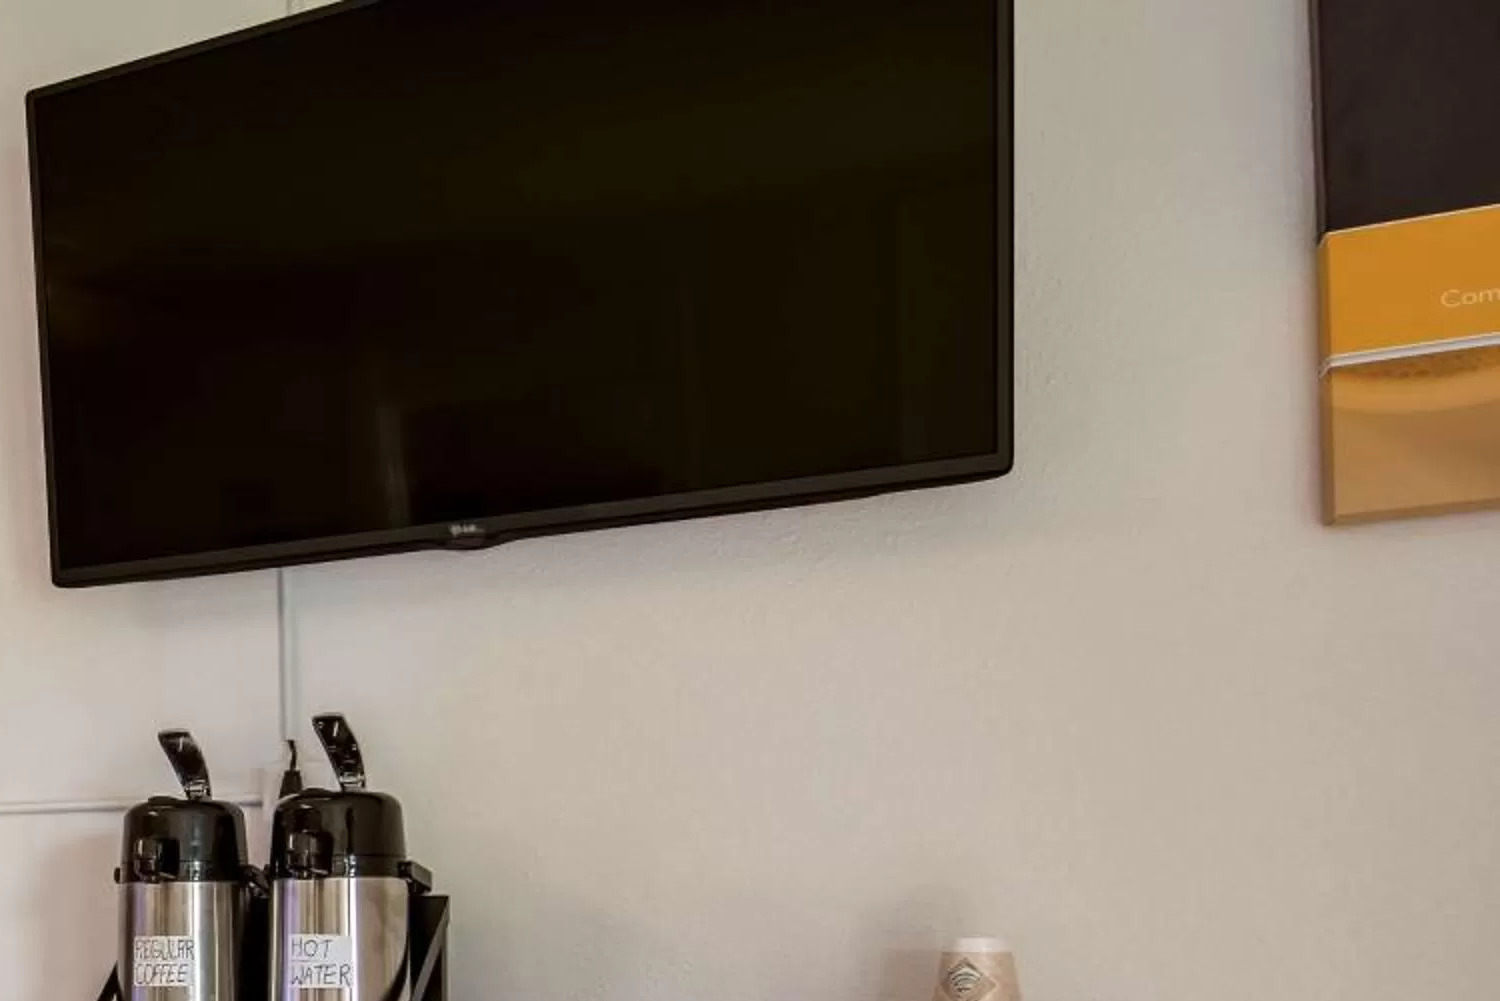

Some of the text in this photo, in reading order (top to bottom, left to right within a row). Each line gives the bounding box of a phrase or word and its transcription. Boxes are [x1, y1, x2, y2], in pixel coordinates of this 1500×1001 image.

[134, 939, 195, 960] REGULAR
[291, 939, 332, 958] HOT
[134, 963, 189, 985] COFFEE
[291, 963, 351, 987] WATER
